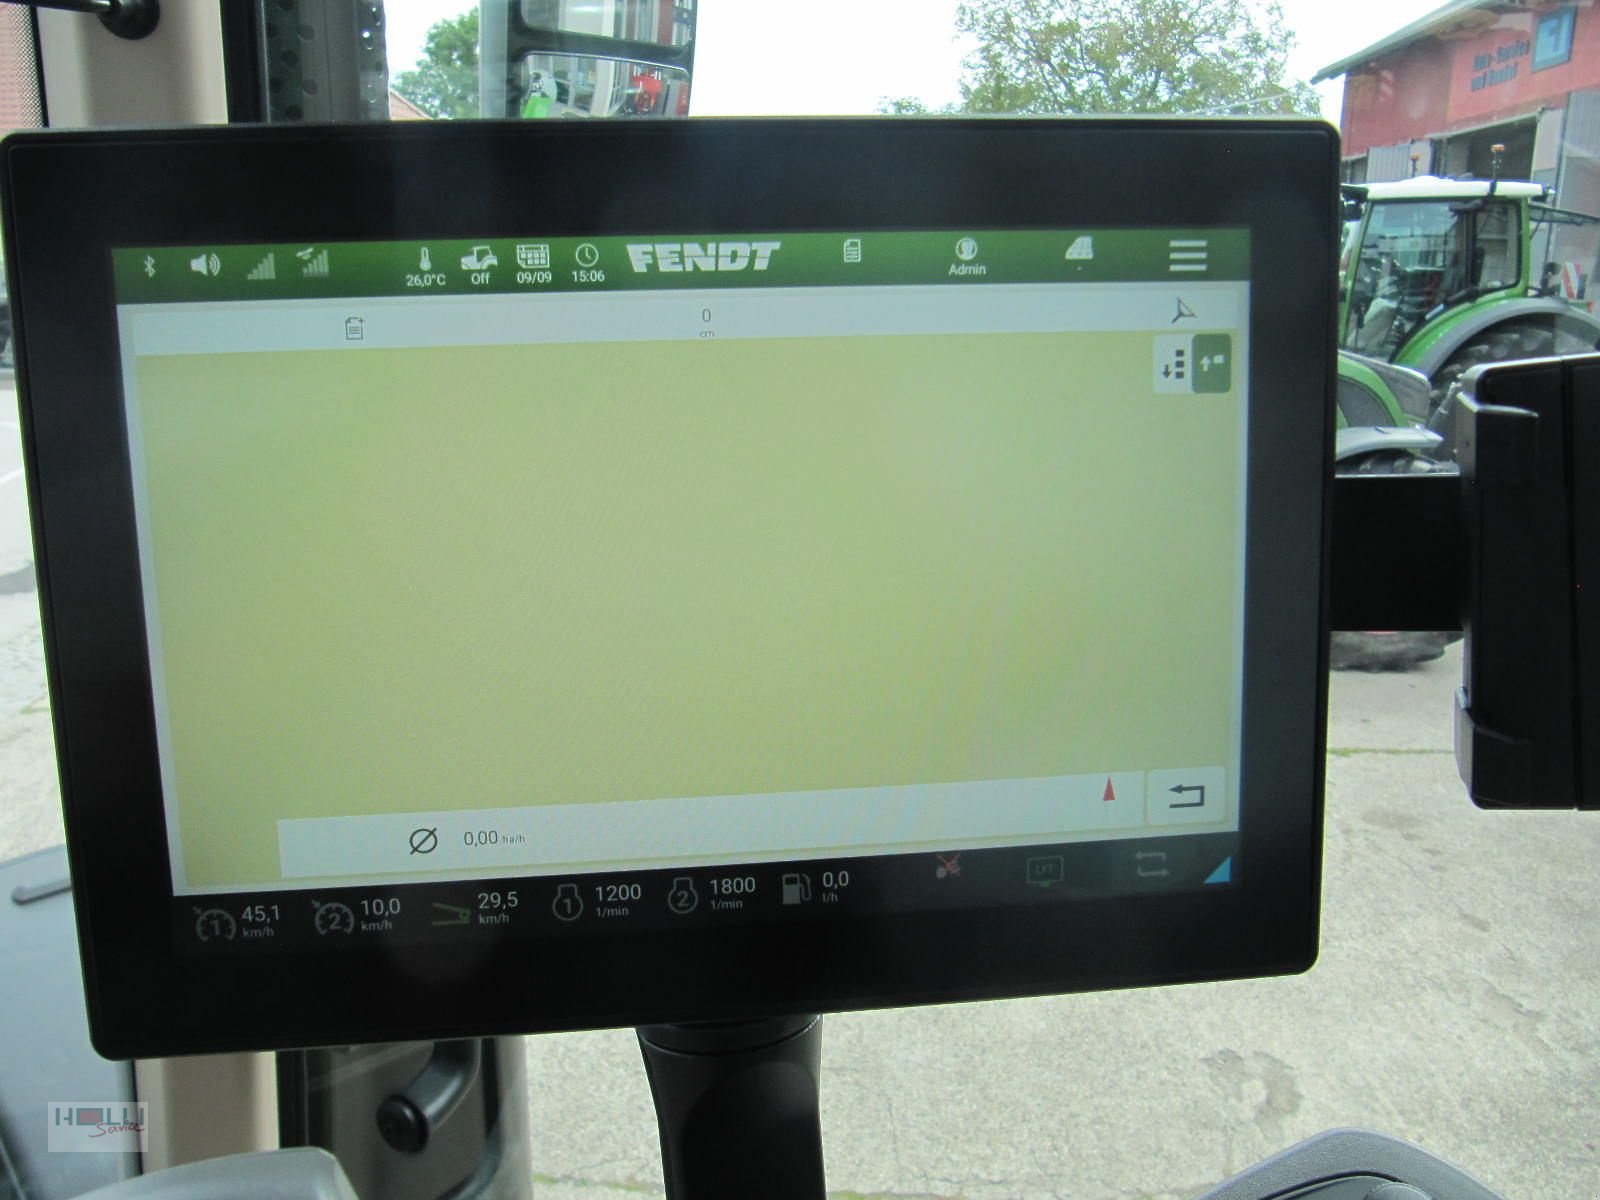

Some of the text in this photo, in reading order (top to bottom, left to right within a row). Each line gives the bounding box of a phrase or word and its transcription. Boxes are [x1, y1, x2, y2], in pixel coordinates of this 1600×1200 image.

[626, 241, 781, 273] FENDT
[572, 269, 605, 283] 15:06
[948, 263, 986, 276] Admin
[406, 273, 447, 287] 26,0°C
[471, 272, 490, 285] Off
[516, 271, 552, 284] 09/09
[702, 308, 712, 323] 0
[700, 330, 715, 338] cm
[463, 830, 526, 848] 0,00 ha/h
[709, 876, 756, 895] 1800
[822, 870, 849, 889] 0,0
[595, 883, 642, 902] 1200
[676, 891, 689, 908] 2
[360, 898, 401, 917] 10,0
[477, 891, 519, 911] 29,5
[562, 898, 572, 914] 1
[710, 898, 743, 910] 1/min
[241, 904, 280, 924] 45,1
[479, 912, 510, 926] km/h
[596, 905, 629, 918] 1/min
[210, 919, 220, 936] 1
[328, 913, 341, 930] 2
[361, 919, 393, 932] km/h
[242, 926, 275, 939] km/h
